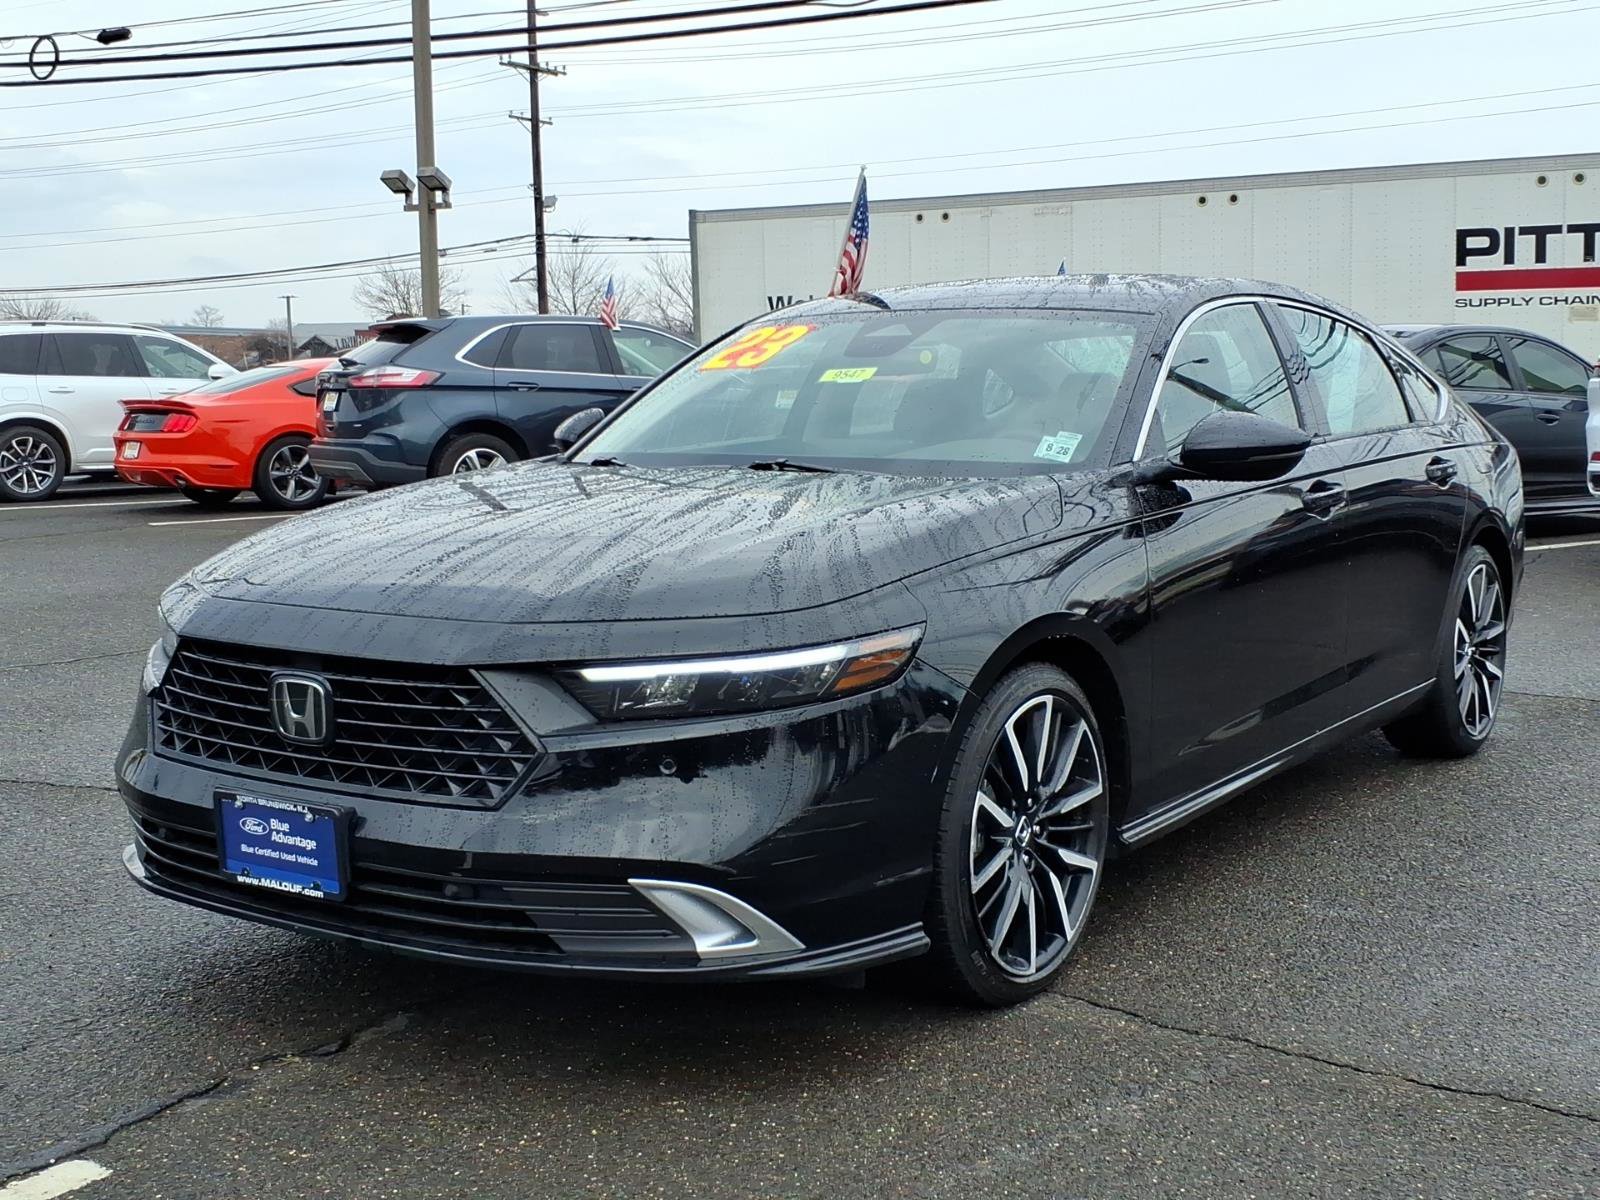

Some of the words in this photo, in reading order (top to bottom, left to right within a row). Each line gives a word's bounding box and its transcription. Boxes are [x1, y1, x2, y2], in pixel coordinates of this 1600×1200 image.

[1456, 223, 1600, 266] PITT
[1455, 297, 1534, 308] SUPPLY
[699, 323, 813, 370] 23
[832, 368, 867, 379] 9547
[1046, 443, 1054, 452] 8
[1056, 446, 1070, 456] 28
[245, 819, 263, 832] Ford
[270, 818, 290, 832] Blue
[271, 832, 317, 850] Advantage
[241, 843, 254, 853] Blue
[254, 846, 280, 858] Certified
[280, 852, 296, 862] Used
[296, 854, 319, 866] Vehicle
[237, 875, 324, 898] www.MALOUF.com
